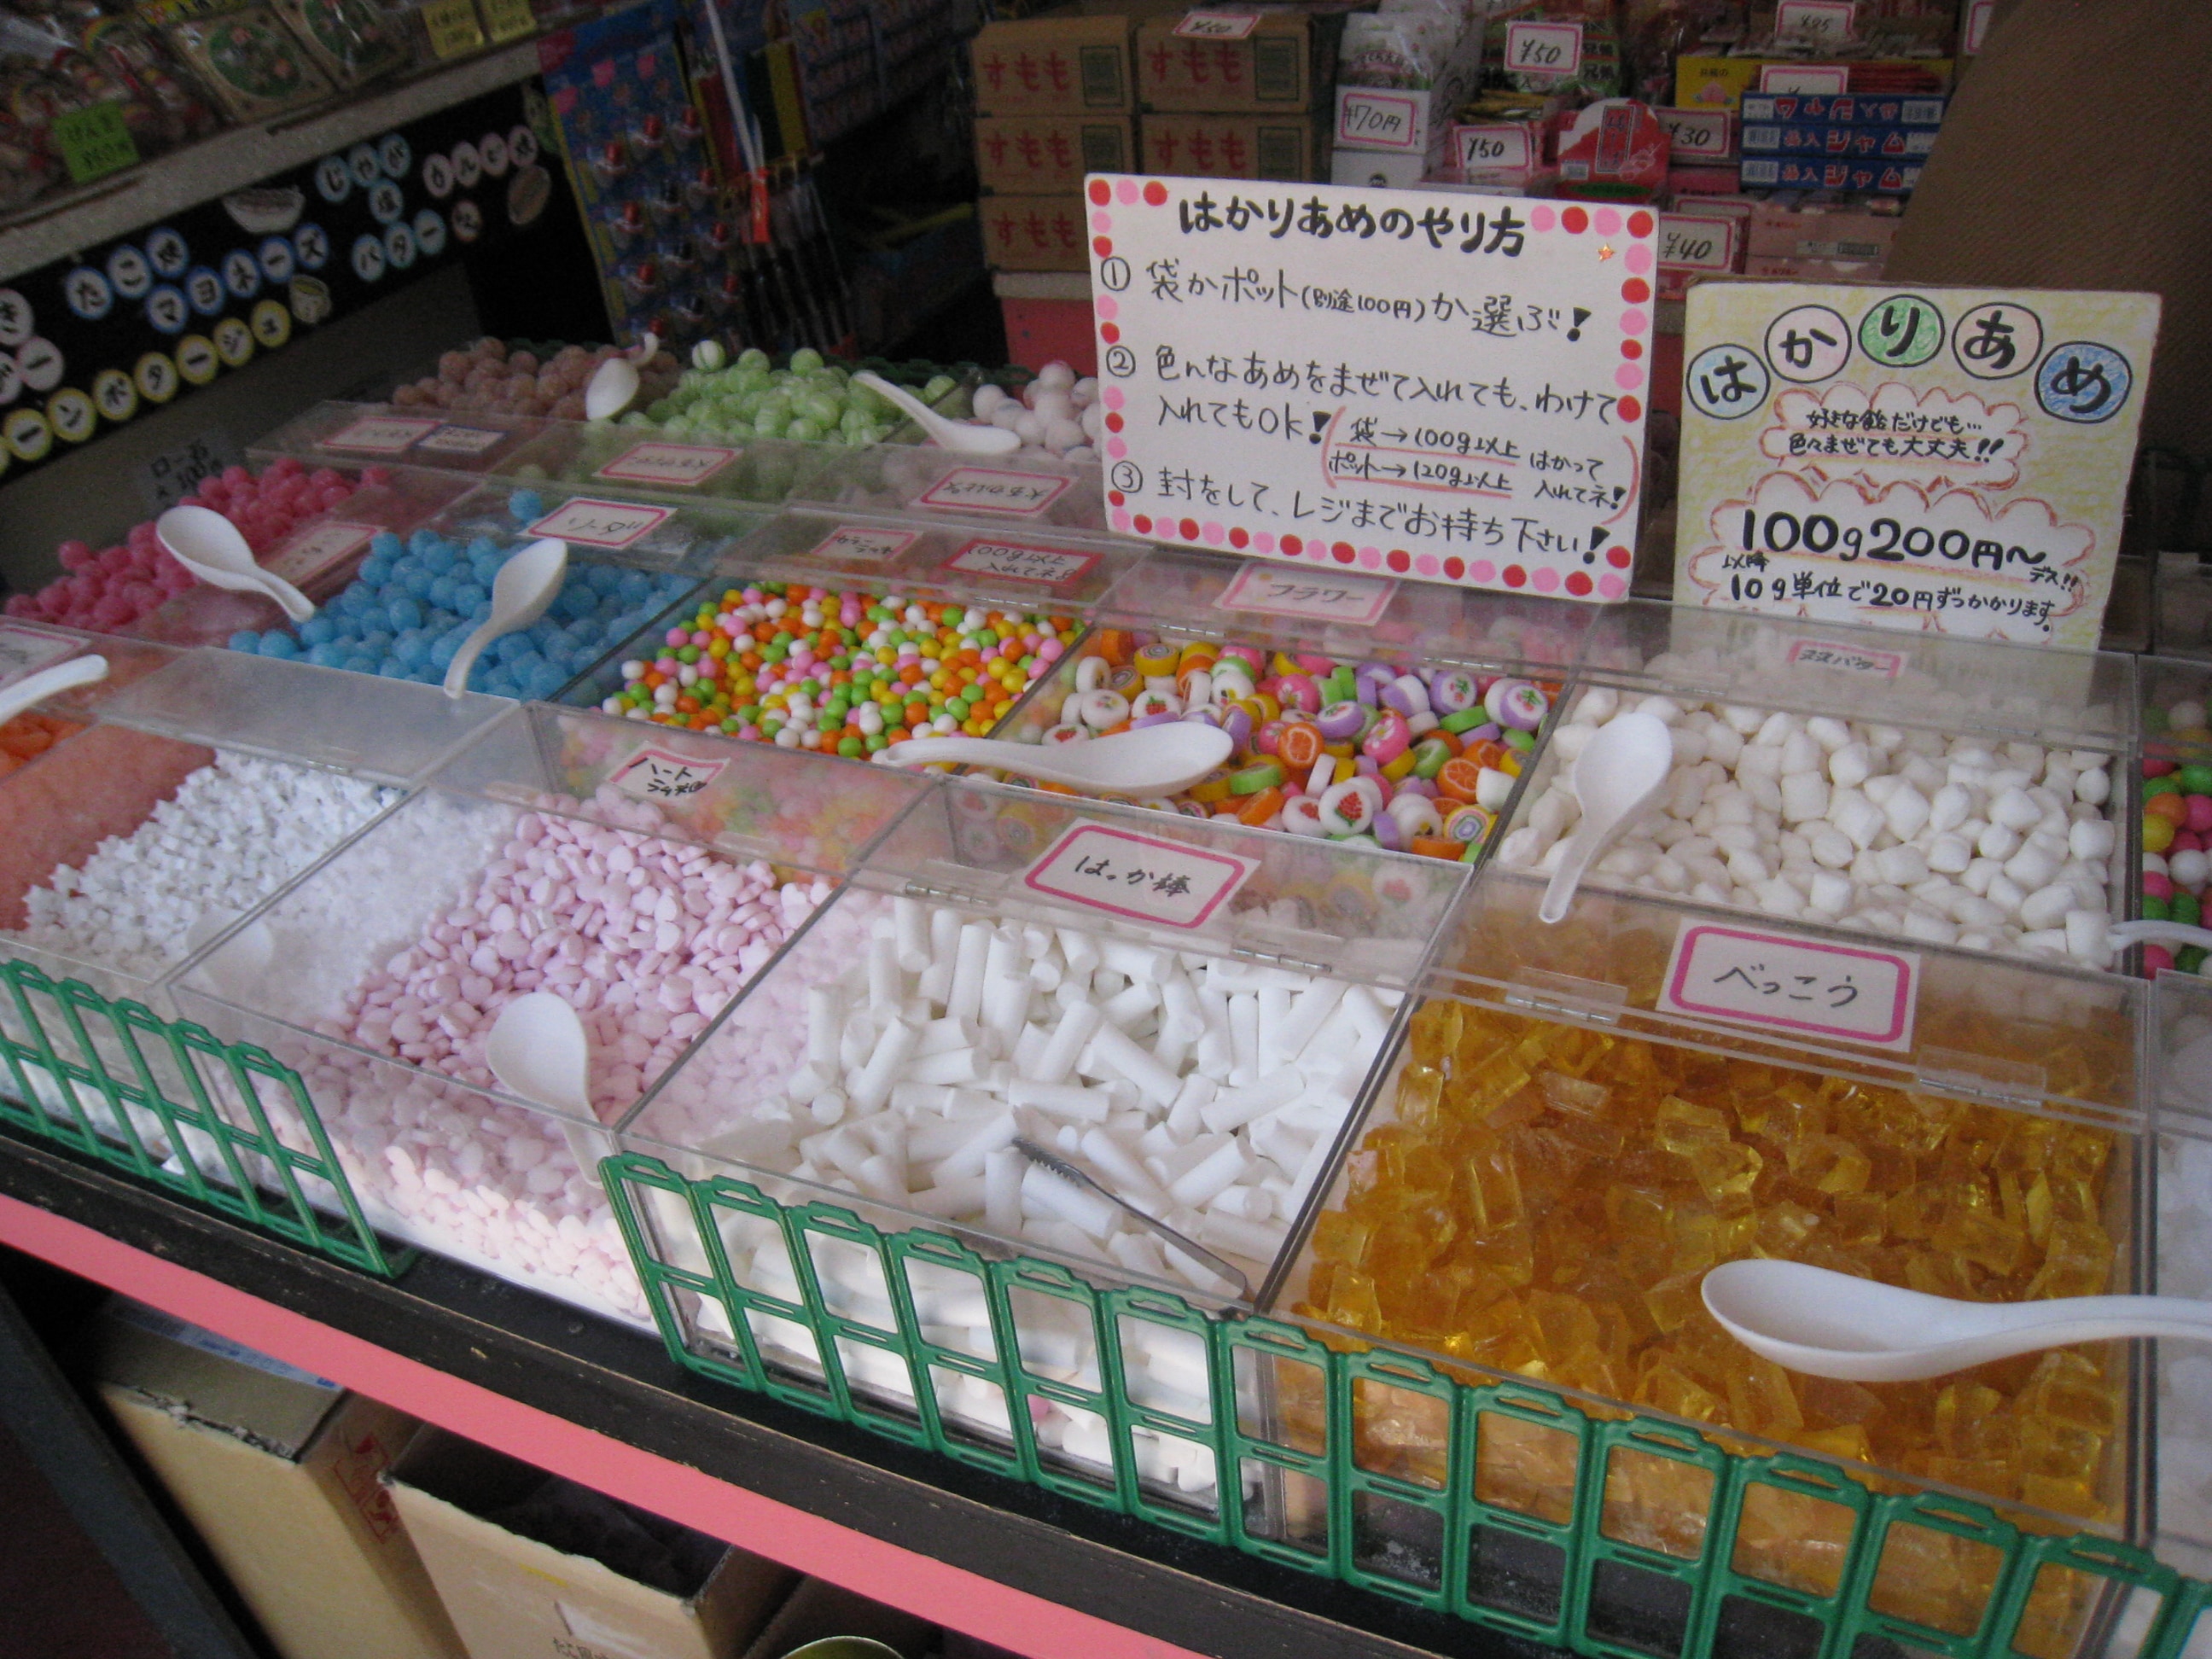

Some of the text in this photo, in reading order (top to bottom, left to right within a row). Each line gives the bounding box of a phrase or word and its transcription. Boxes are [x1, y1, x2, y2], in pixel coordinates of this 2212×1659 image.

[983, 50, 1068, 91] すもも
[986, 130, 1072, 169] すもも
[1154, 129, 1247, 170] すもも
[992, 211, 1077, 248] すもも
[1179, 191, 1526, 256] はかりあめのやり方
[1663, 232, 1714, 260] ¥40
[1267, 583, 1365, 604] フラワー
[1074, 854, 1190, 898] はっか棒
[1713, 963, 1858, 1008] べっこう
